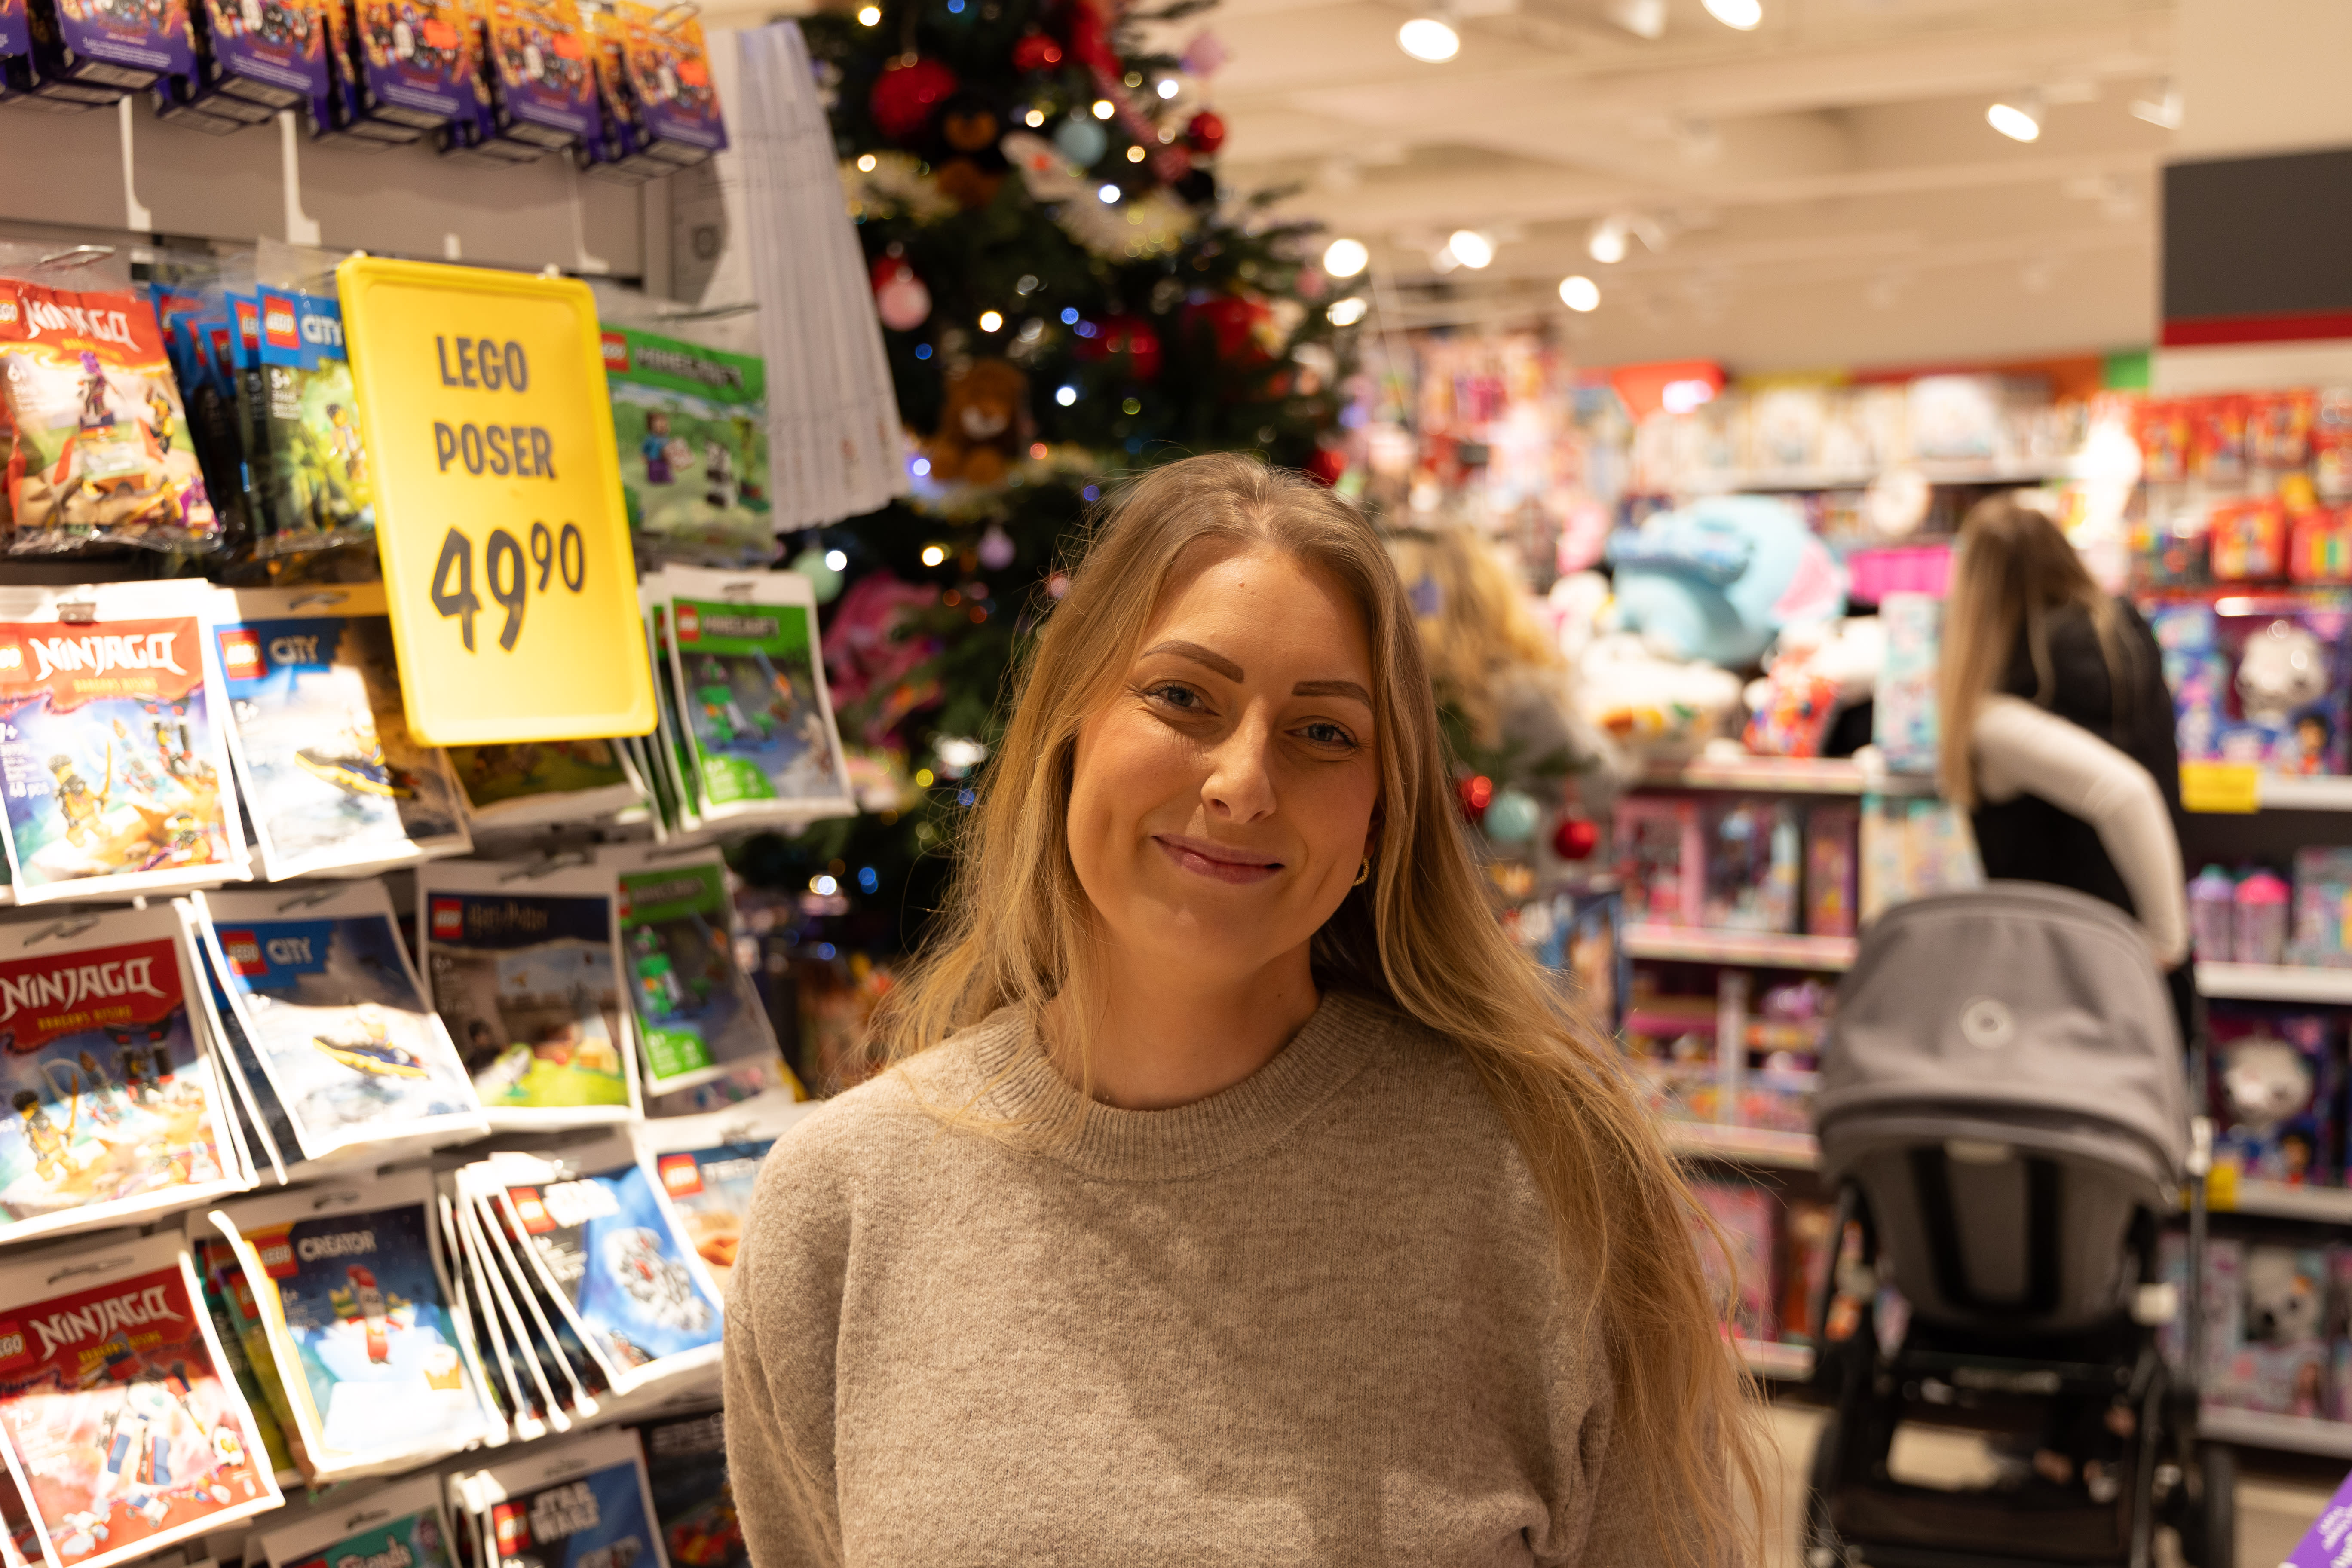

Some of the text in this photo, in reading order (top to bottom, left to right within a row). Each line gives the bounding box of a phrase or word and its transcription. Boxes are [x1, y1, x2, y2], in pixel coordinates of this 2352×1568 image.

[302, 314, 343, 347] CITY
[436, 334, 529, 392] LEGO
[434, 422, 556, 479] POSER
[28, 632, 188, 682] NINJAGO
[269, 635, 319, 665] CITY
[266, 937, 313, 965] CITY
[0, 956, 168, 1023] NINJAGO
[298, 1231, 377, 1262] CREATOR
[0, 1285, 186, 1362] GO NINJAGO
